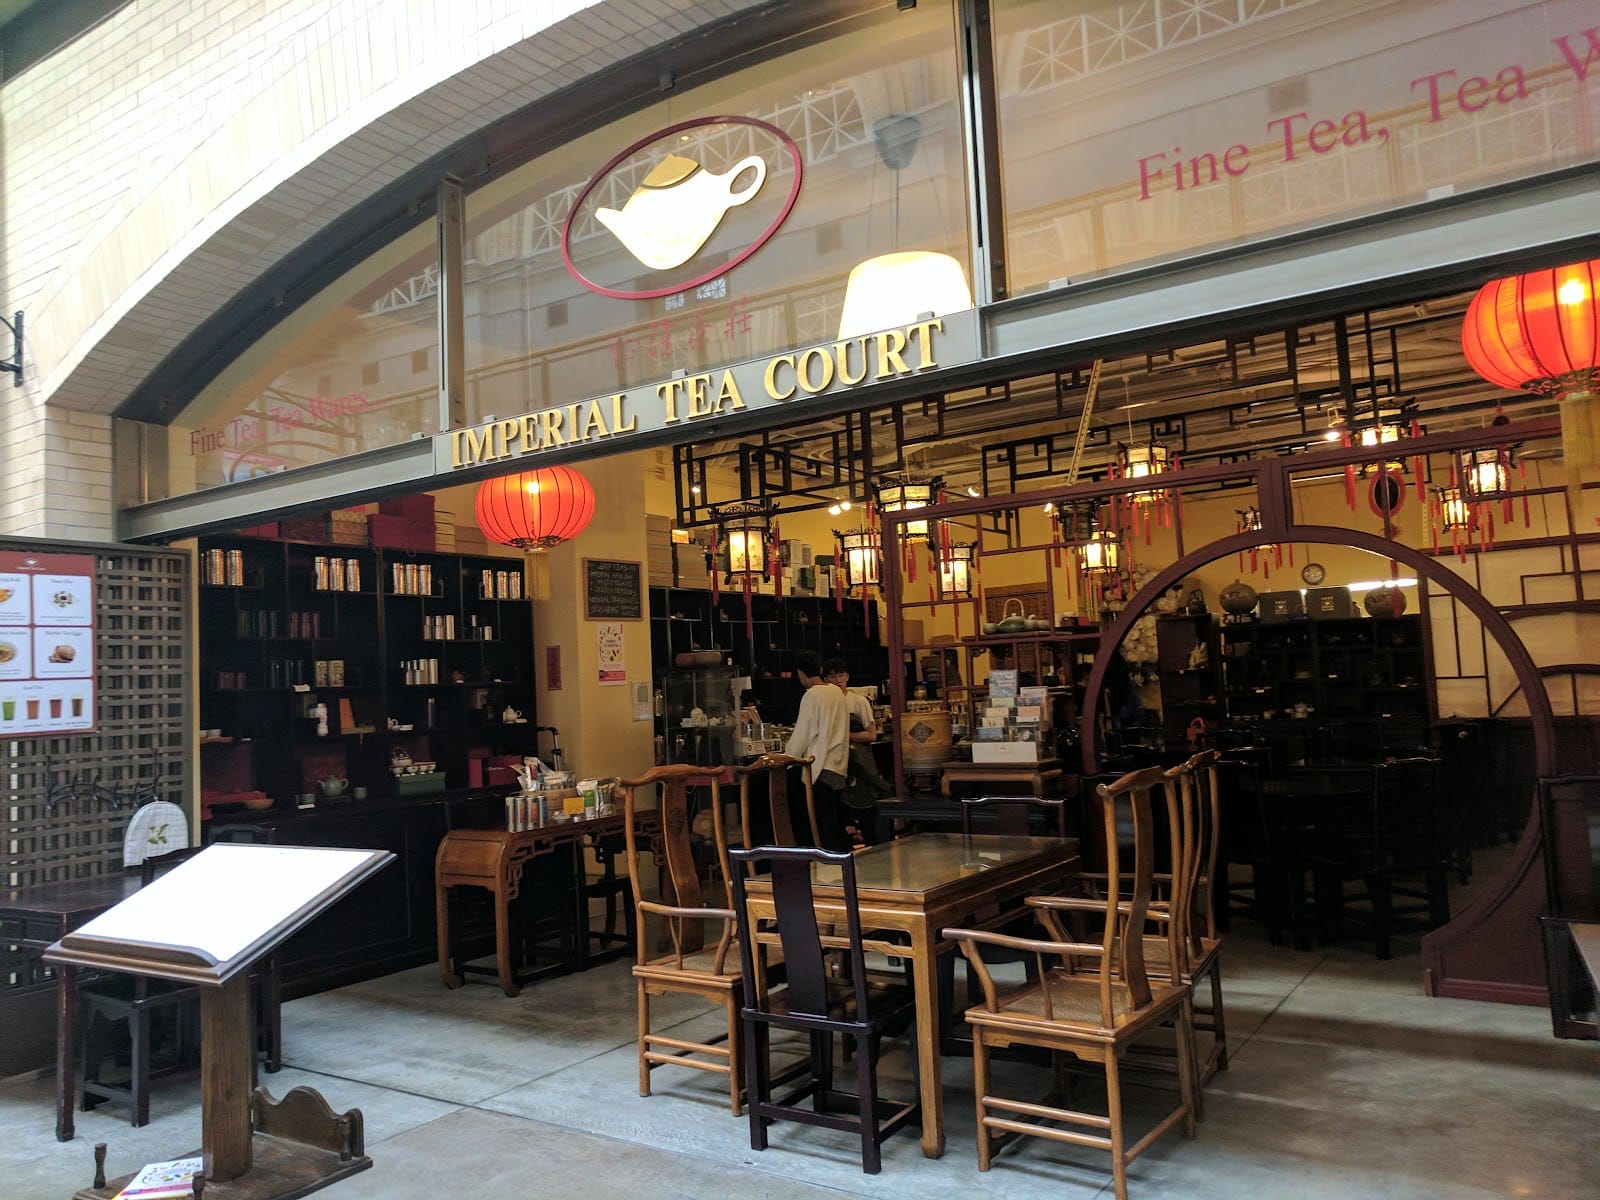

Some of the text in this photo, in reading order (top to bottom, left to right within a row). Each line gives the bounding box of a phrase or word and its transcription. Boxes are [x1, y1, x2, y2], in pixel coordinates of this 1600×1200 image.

[1137, 143, 1251, 201] Fine
[1266, 111, 1391, 163] Tea,
[1410, 63, 1531, 123] Tea
[190, 427, 226, 457] Fine
[269, 405, 303, 435] Tea
[449, 316, 944, 470] IMPERIAL TEA COURT
